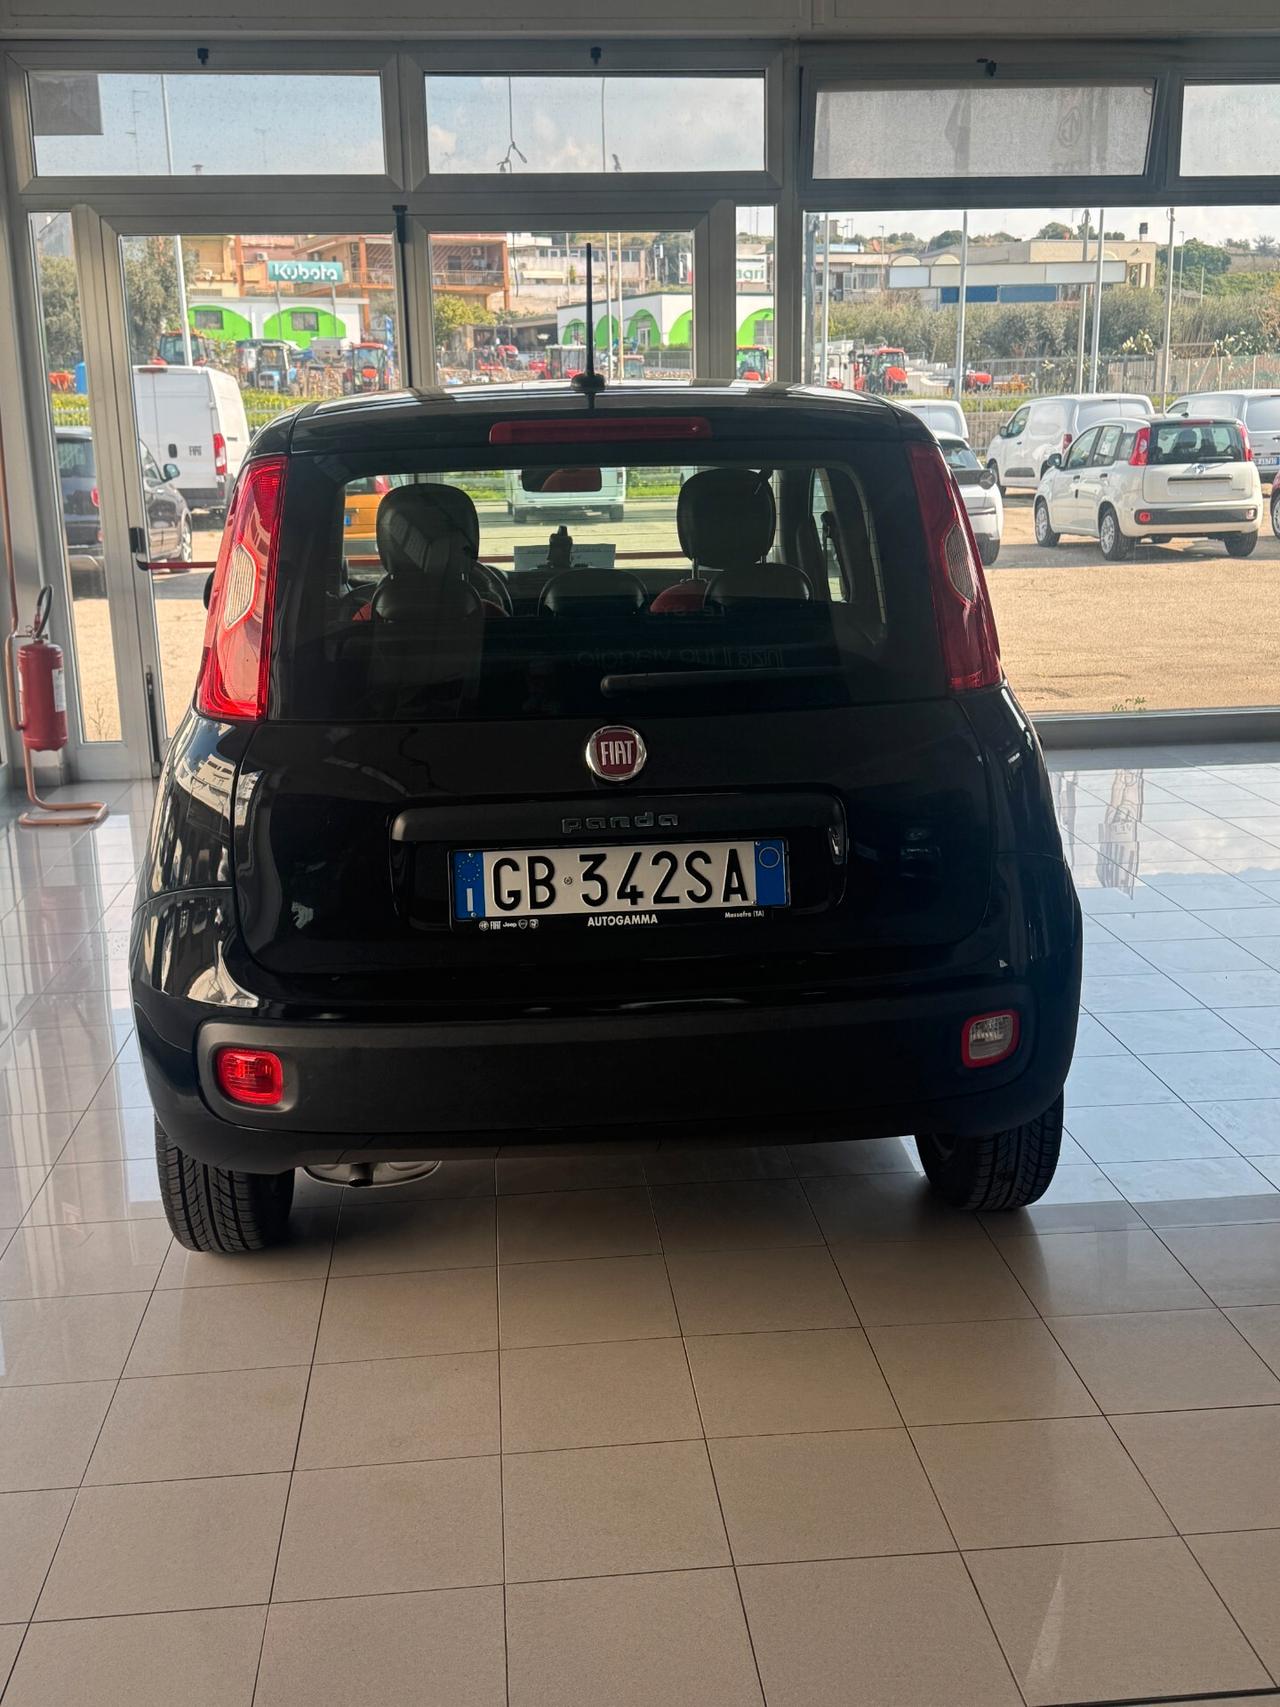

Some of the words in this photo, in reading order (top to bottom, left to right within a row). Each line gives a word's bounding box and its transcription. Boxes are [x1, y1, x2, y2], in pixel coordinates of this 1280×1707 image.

[273, 263, 338, 281] Kubota
[600, 740, 634, 766] FIAT
[561, 811, 680, 835] panda
[493, 856, 556, 911] GB
[578, 848, 749, 907] 342SA
[587, 913, 658, 927] AUTOGAMMA
